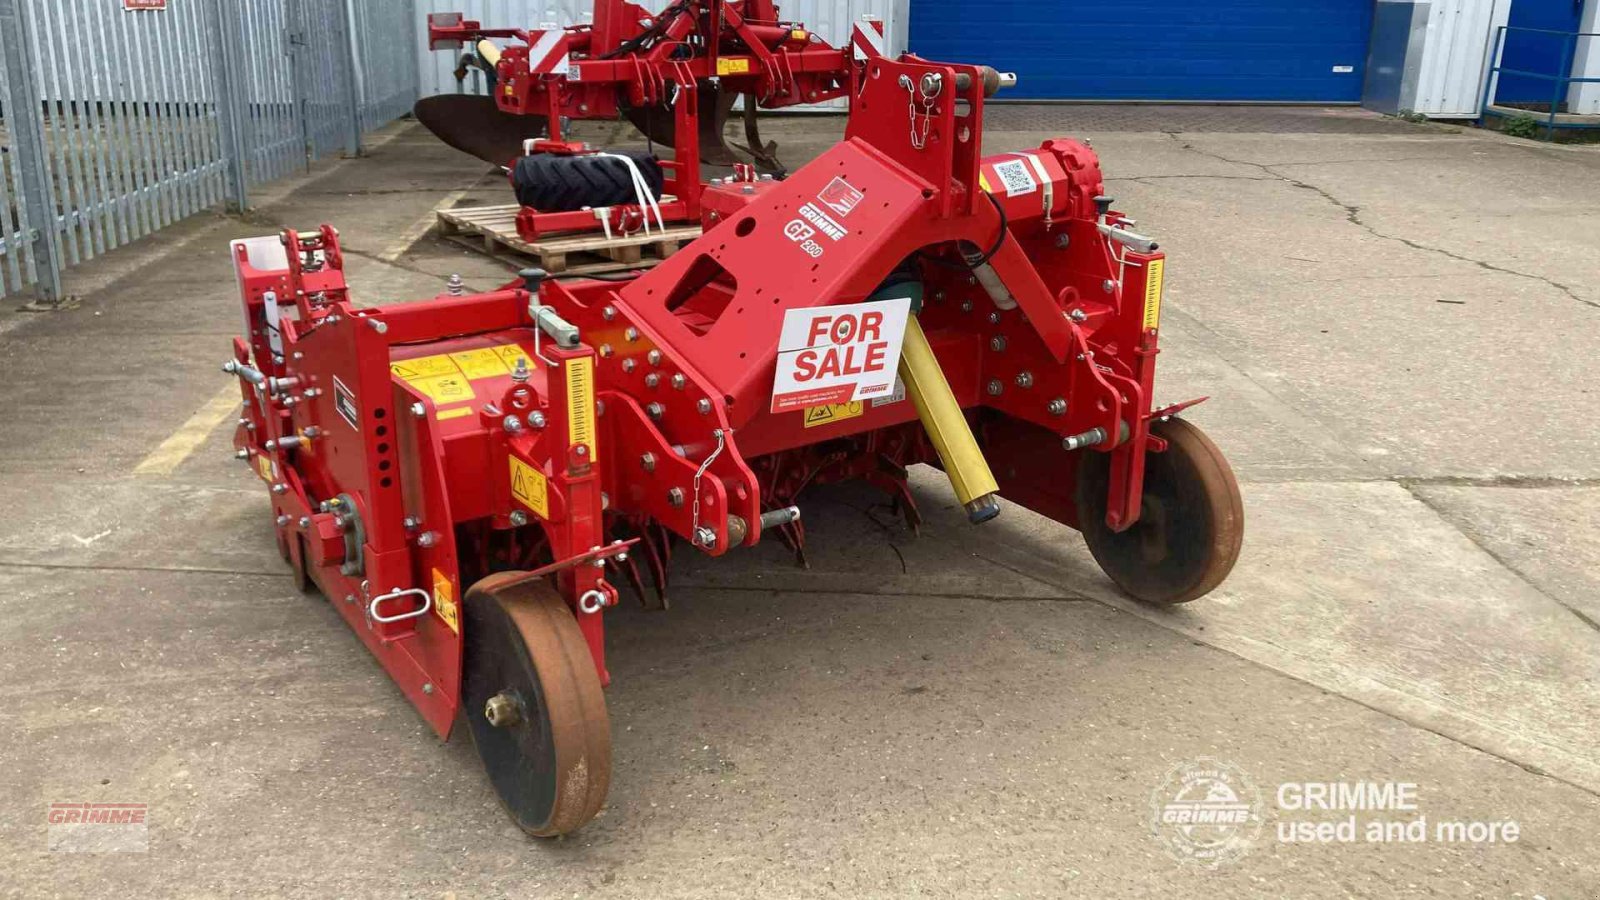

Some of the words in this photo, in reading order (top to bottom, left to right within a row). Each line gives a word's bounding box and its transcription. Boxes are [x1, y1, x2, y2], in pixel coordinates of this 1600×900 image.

[784, 219, 816, 242] GF
[800, 239, 824, 258] 200
[799, 202, 848, 241] GRIMME
[807, 311, 883, 347] FOR
[793, 341, 888, 382] SALE
